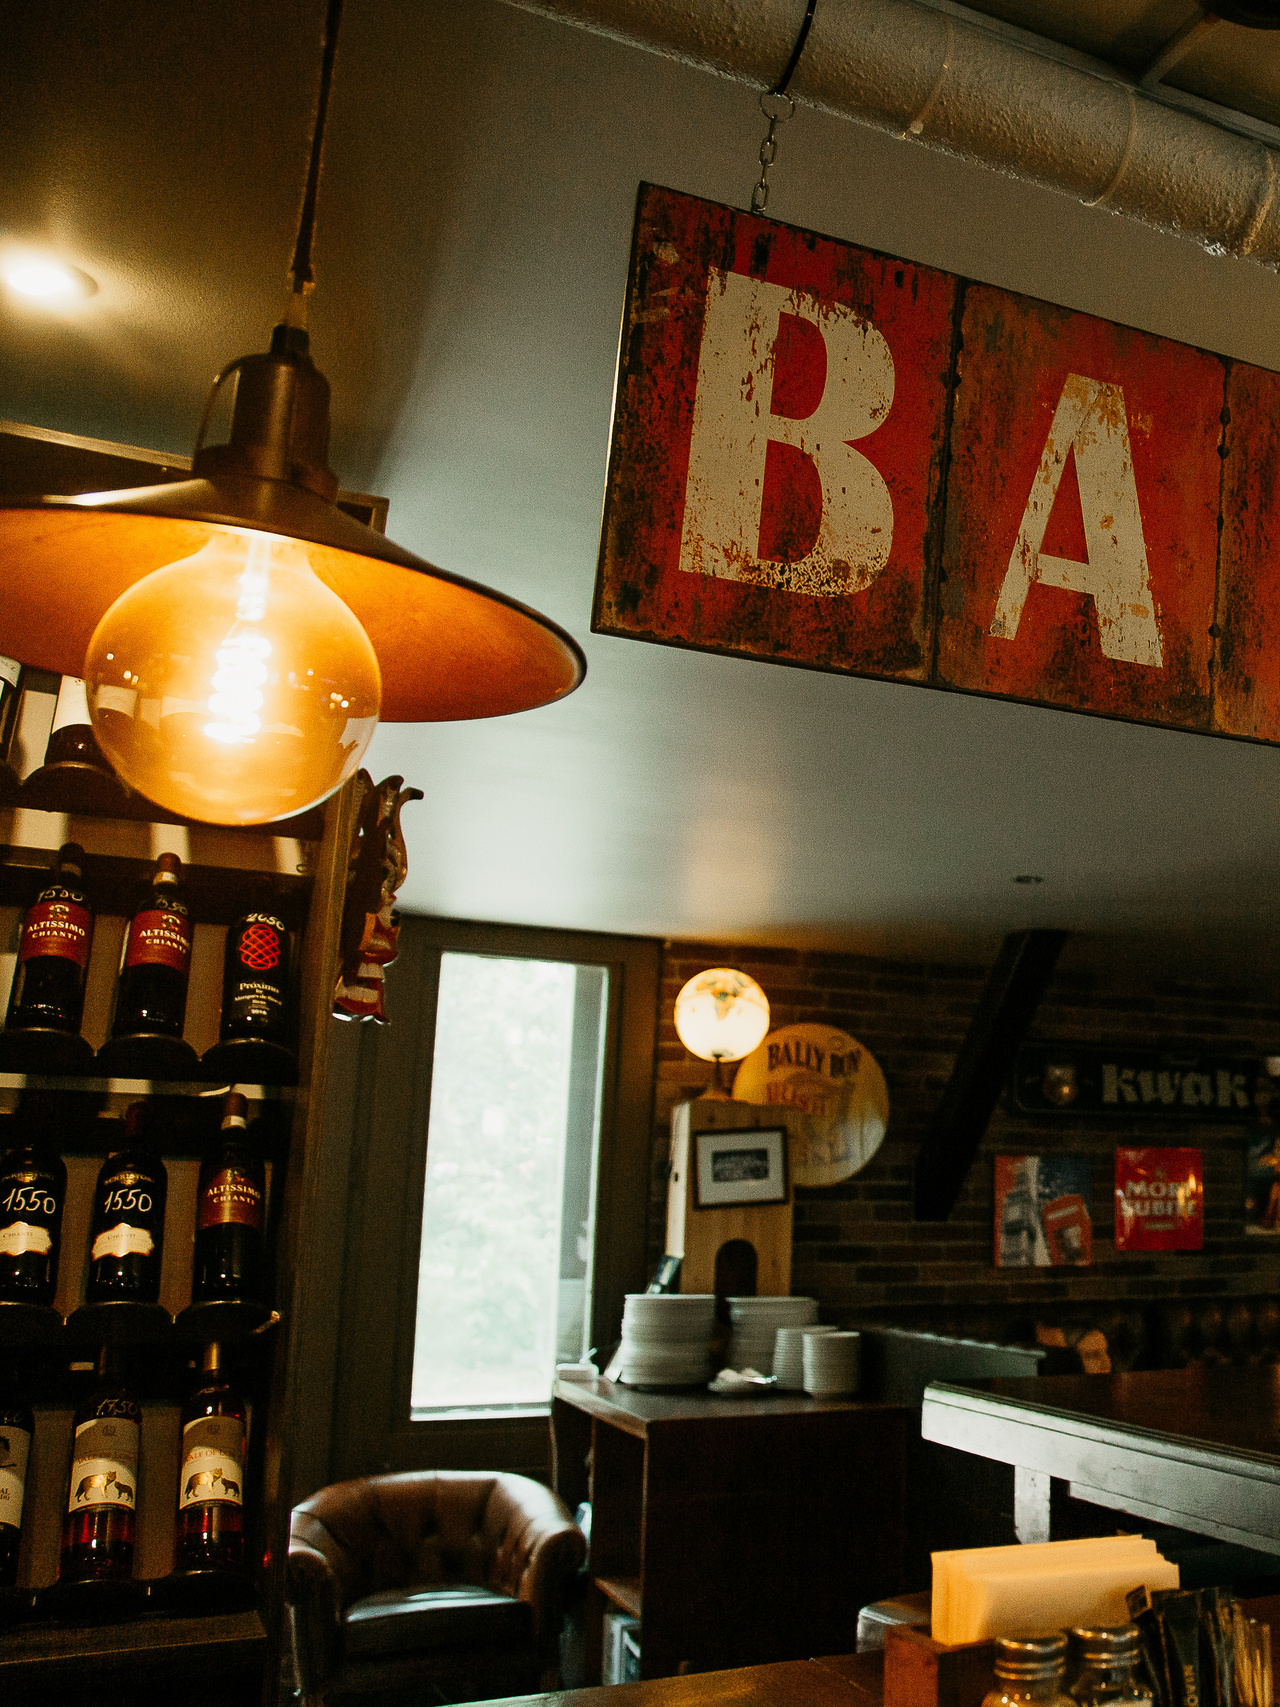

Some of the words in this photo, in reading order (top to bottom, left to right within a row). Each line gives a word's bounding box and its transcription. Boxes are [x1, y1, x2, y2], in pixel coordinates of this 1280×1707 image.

[27, 921, 86, 936] ALTISSIMO
[32, 930, 77, 940] CHIANTI
[206, 1184, 261, 1199] ALTISSIMO
[2, 1186, 57, 1215] 1550
[103, 1188, 153, 1213] 1550
[212, 1194, 255, 1206] CHIANTI
